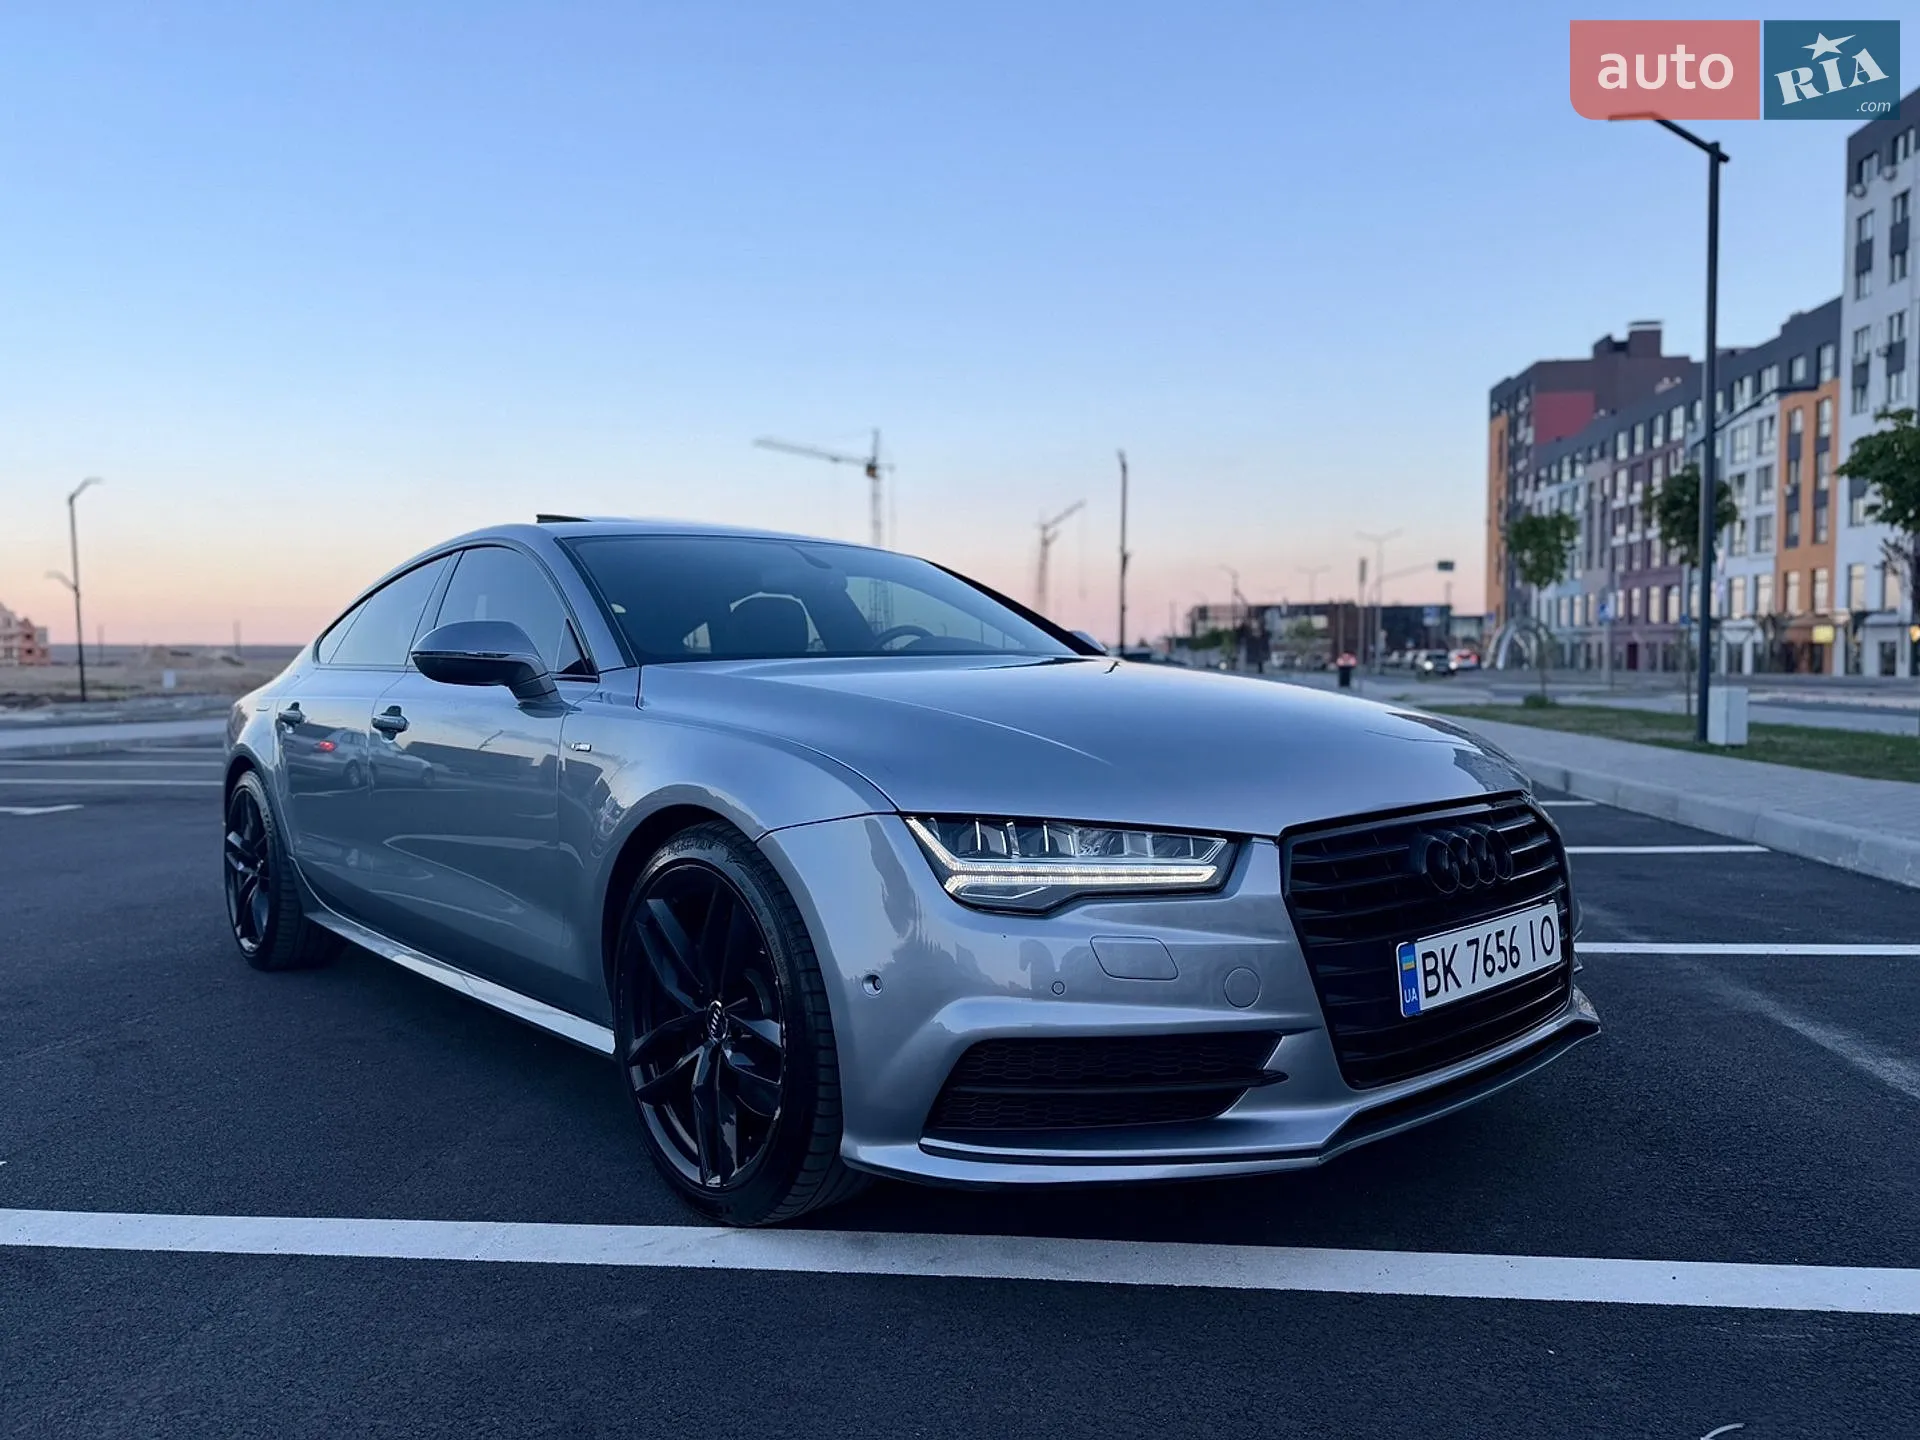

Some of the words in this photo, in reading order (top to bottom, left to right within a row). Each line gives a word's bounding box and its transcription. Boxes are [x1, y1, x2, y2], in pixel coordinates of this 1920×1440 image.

[1421, 943, 1462, 999] BK
[1467, 926, 1520, 984] 7656
[1404, 988, 1418, 1004] UA
